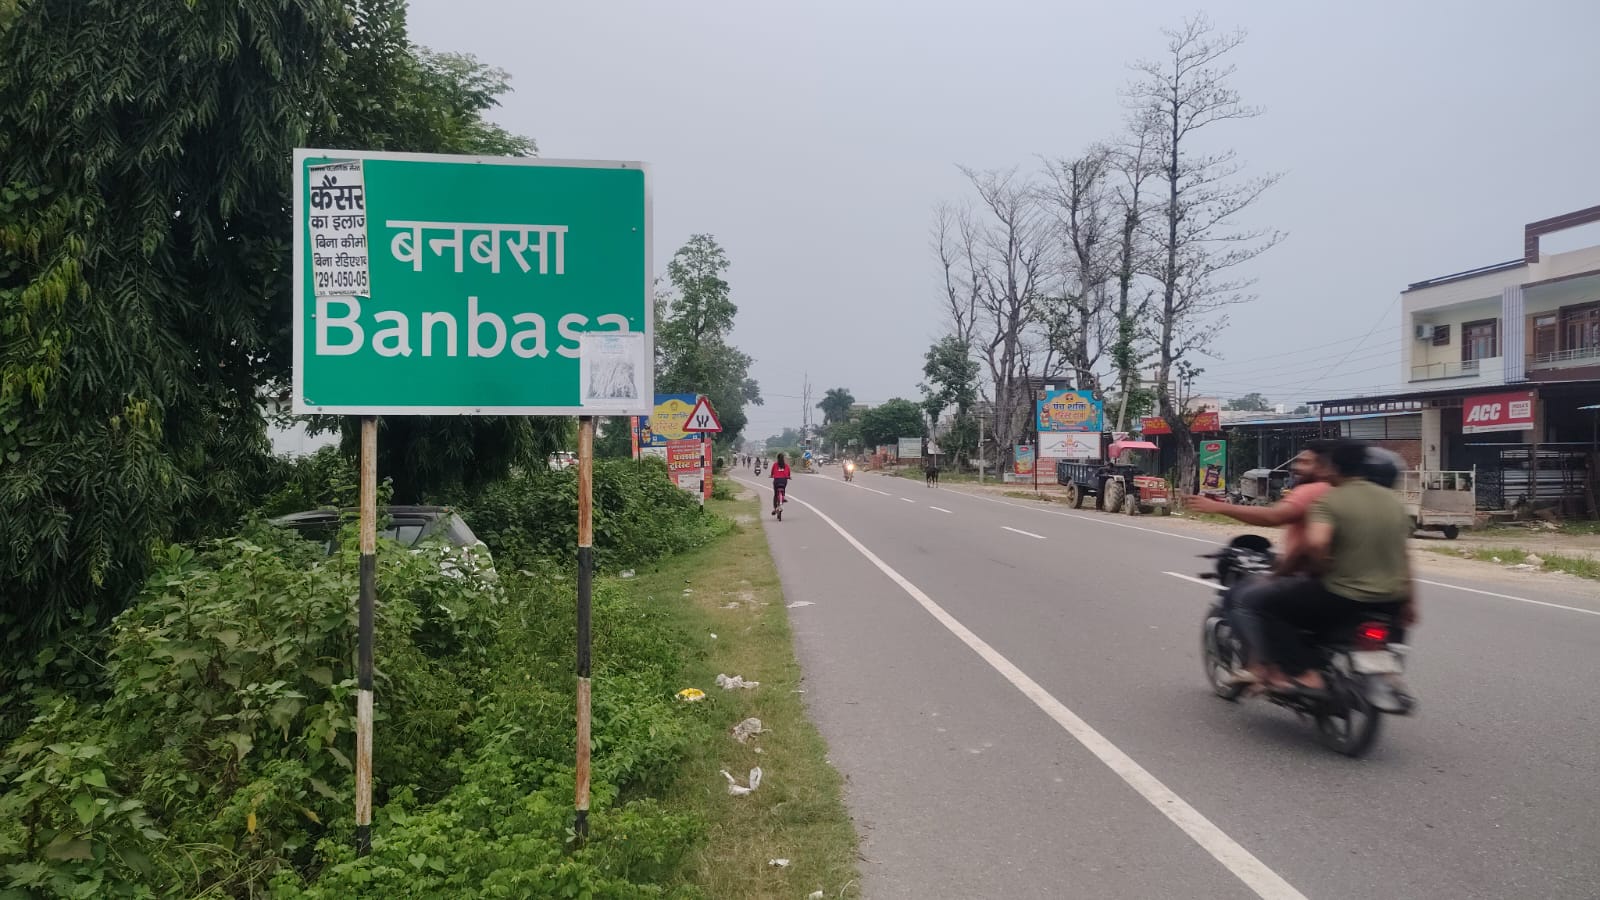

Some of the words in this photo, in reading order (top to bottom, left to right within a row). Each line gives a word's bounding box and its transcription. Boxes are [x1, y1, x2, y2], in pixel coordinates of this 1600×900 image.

[311, 174, 364, 210] कैंसर
[311, 215, 328, 229] का
[315, 233, 338, 249] बिना
[340, 233, 367, 249] कीमो
[386, 219, 569, 275] बनबसा
[315, 270, 367, 288] 291-050-05
[1467, 403, 1501, 422] ACC
